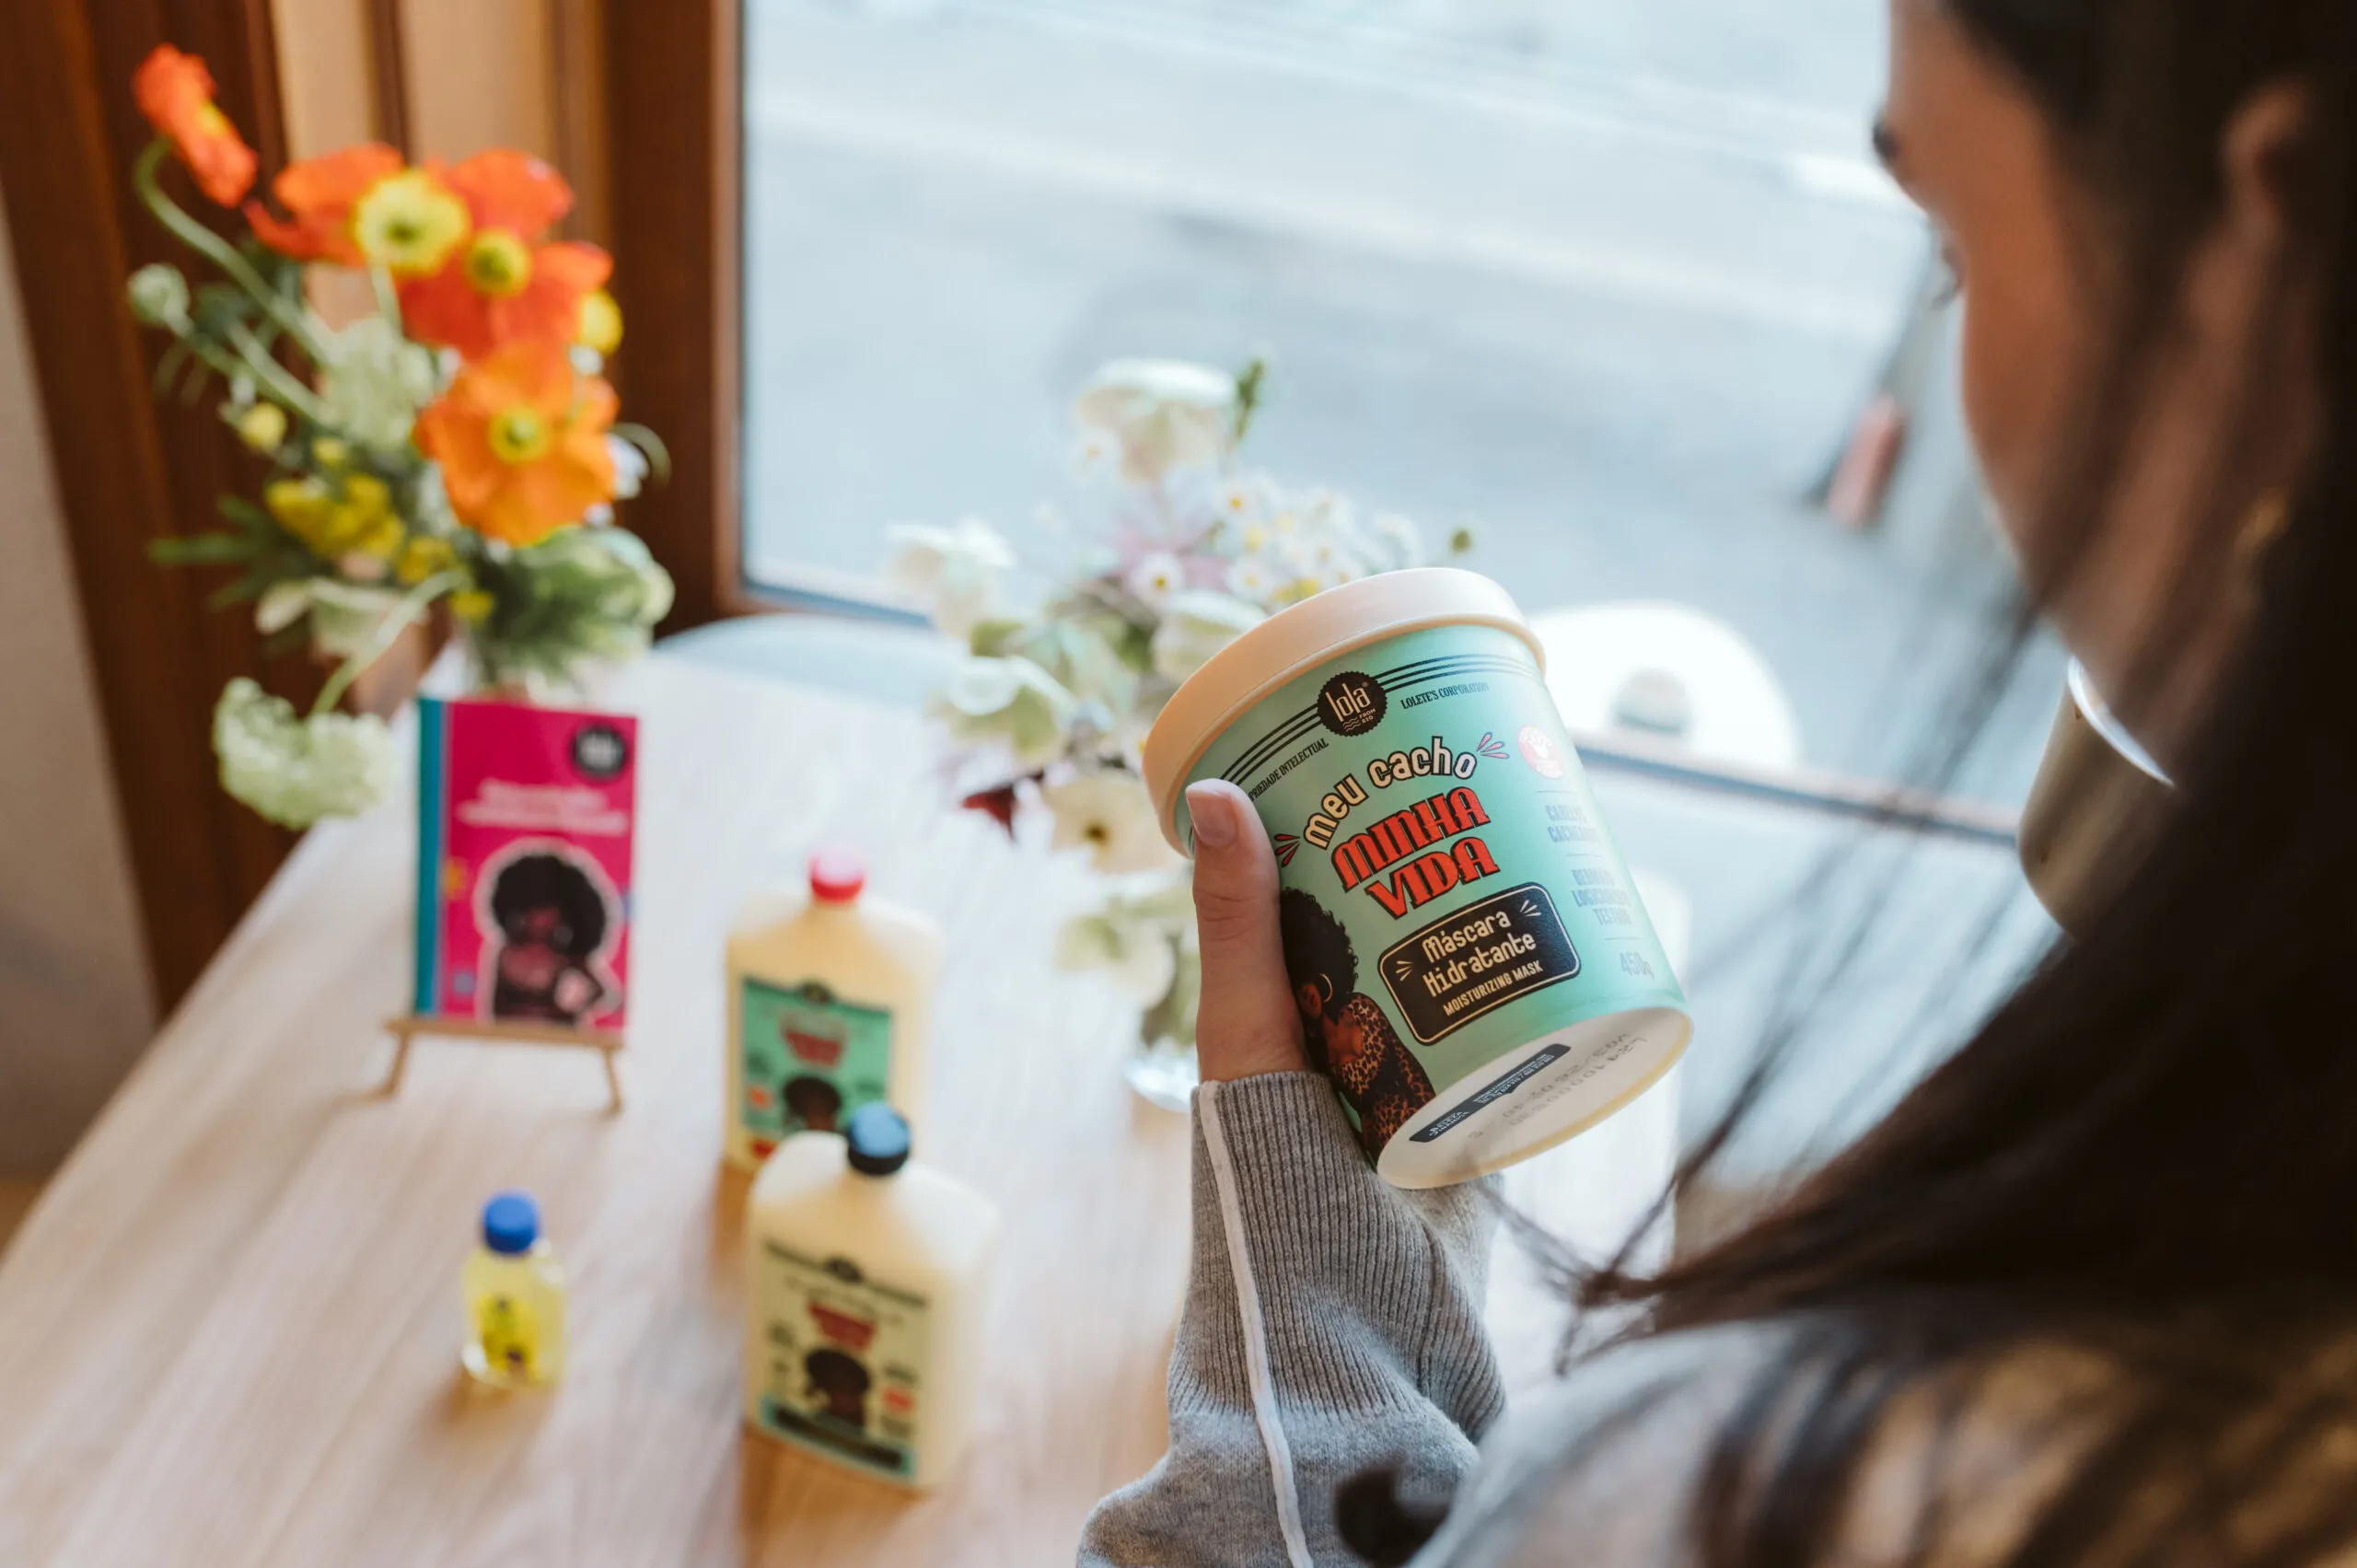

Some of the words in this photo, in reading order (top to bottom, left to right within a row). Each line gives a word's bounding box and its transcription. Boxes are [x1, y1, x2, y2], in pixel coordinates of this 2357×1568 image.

[1326, 683, 1371, 723] lola
[1360, 708, 1376, 718] FROM
[1400, 691, 1439, 709] LOLETE'S
[1248, 769, 1281, 802] PRIEDADE
[1279, 738, 1329, 776] INTELECTUAL
[1303, 773, 1369, 850] meu
[1367, 735, 1477, 789] cacho
[1331, 786, 1491, 893] MINHA
[1364, 837, 1501, 920] VIDA
[1422, 911, 1511, 963] Máscara
[1422, 933, 1536, 997] Hidratante
[1443, 972, 1512, 1016] MOISTURIZING
[1513, 959, 1544, 981] MASK
